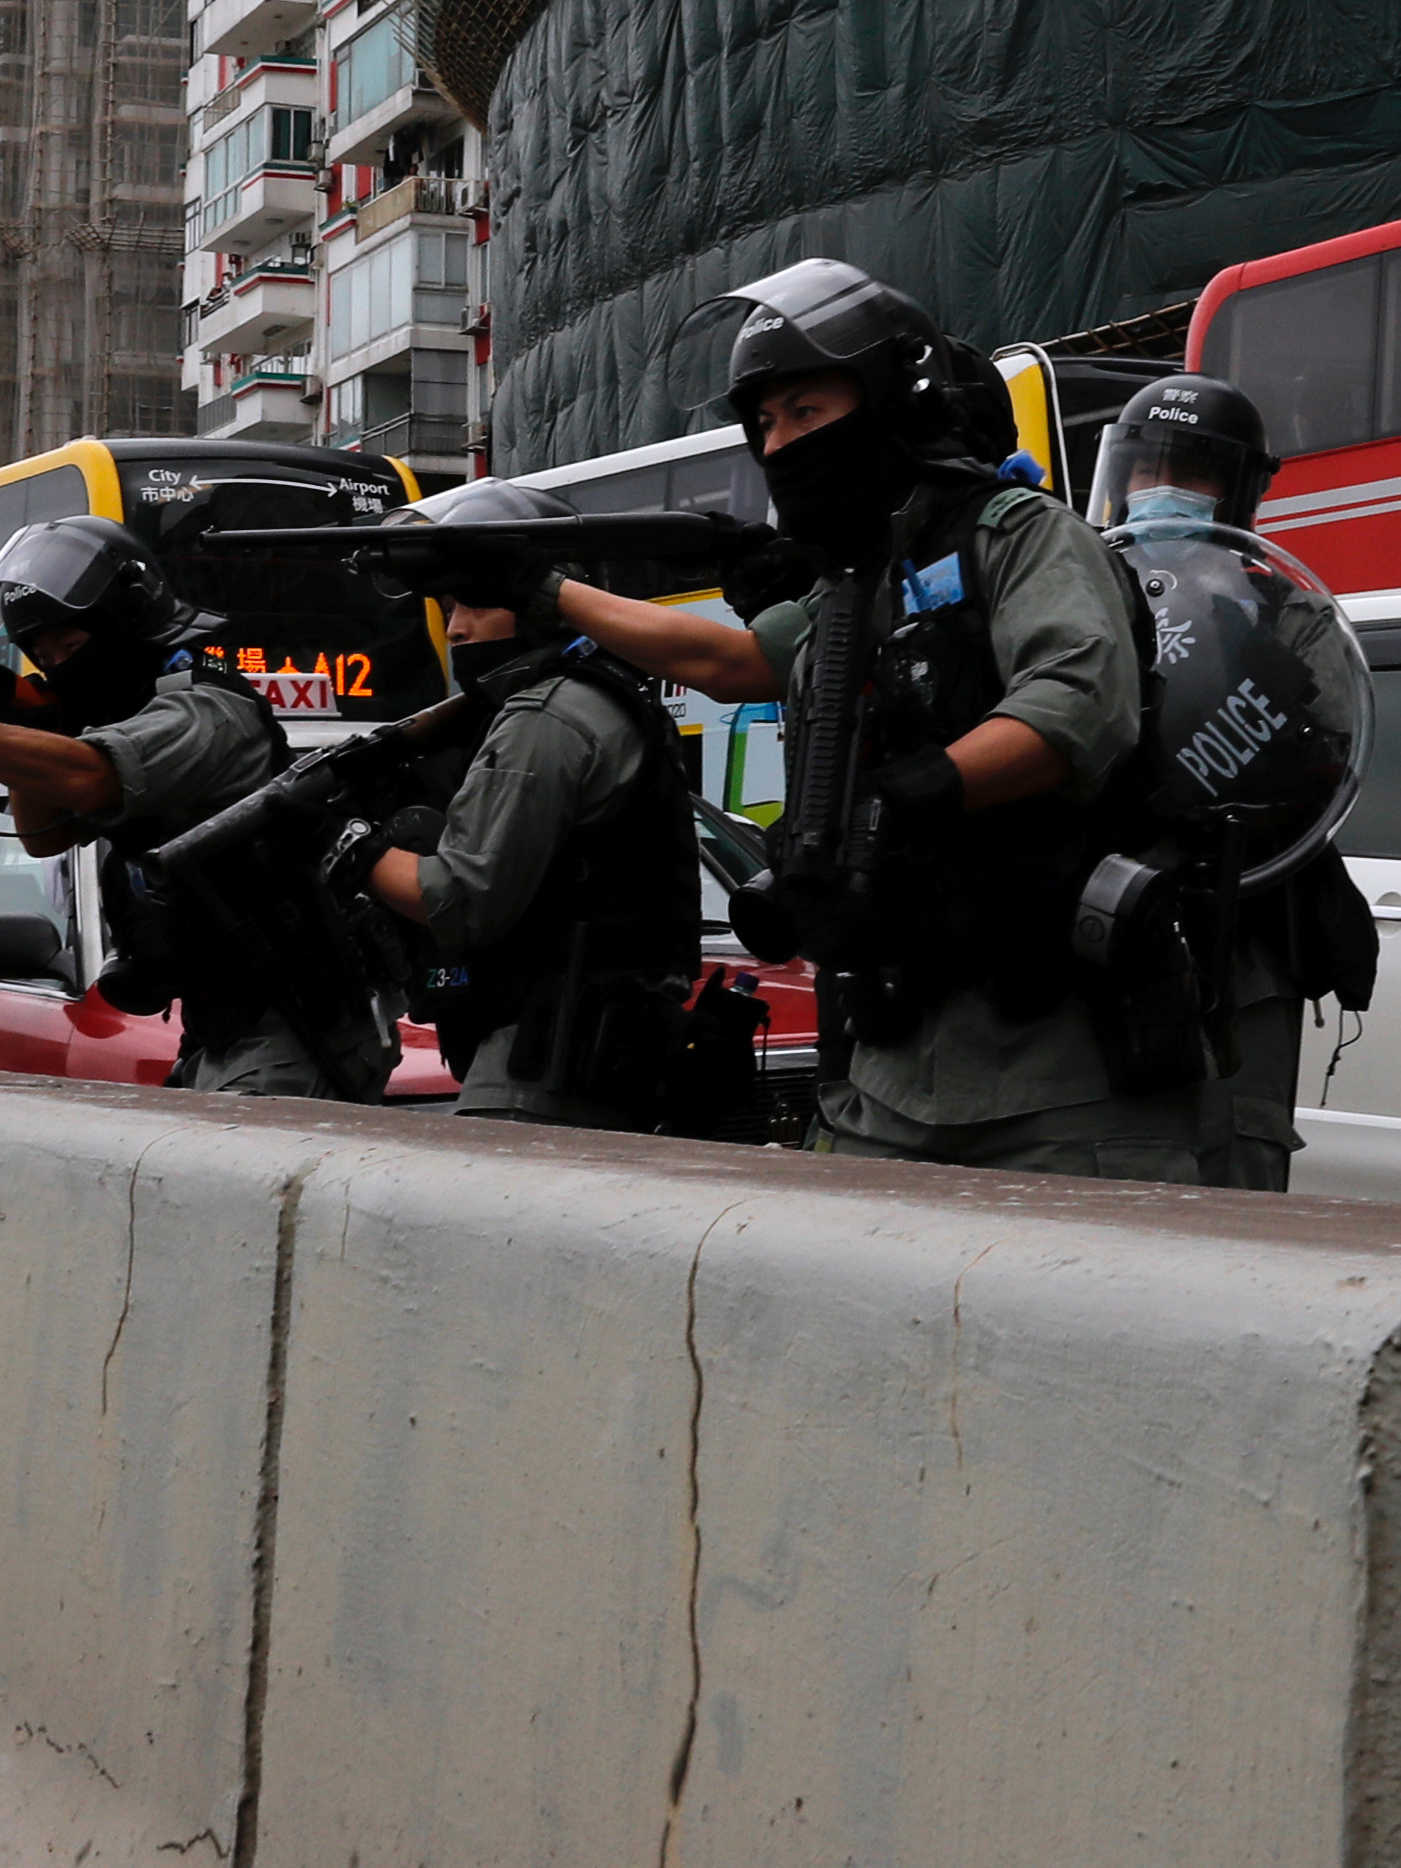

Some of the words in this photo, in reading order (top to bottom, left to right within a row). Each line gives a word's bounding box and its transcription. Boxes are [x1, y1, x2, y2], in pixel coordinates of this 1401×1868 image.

[1148, 406, 1199, 425] Police
[148, 469, 182, 486] City
[140, 486, 195, 503] 市中心
[339, 478, 391, 496] Airport
[352, 496, 384, 514] 機場
[314, 651, 373, 697] A12
[1176, 678, 1288, 797] POLICE
[427, 967, 469, 988] Z3-2A
